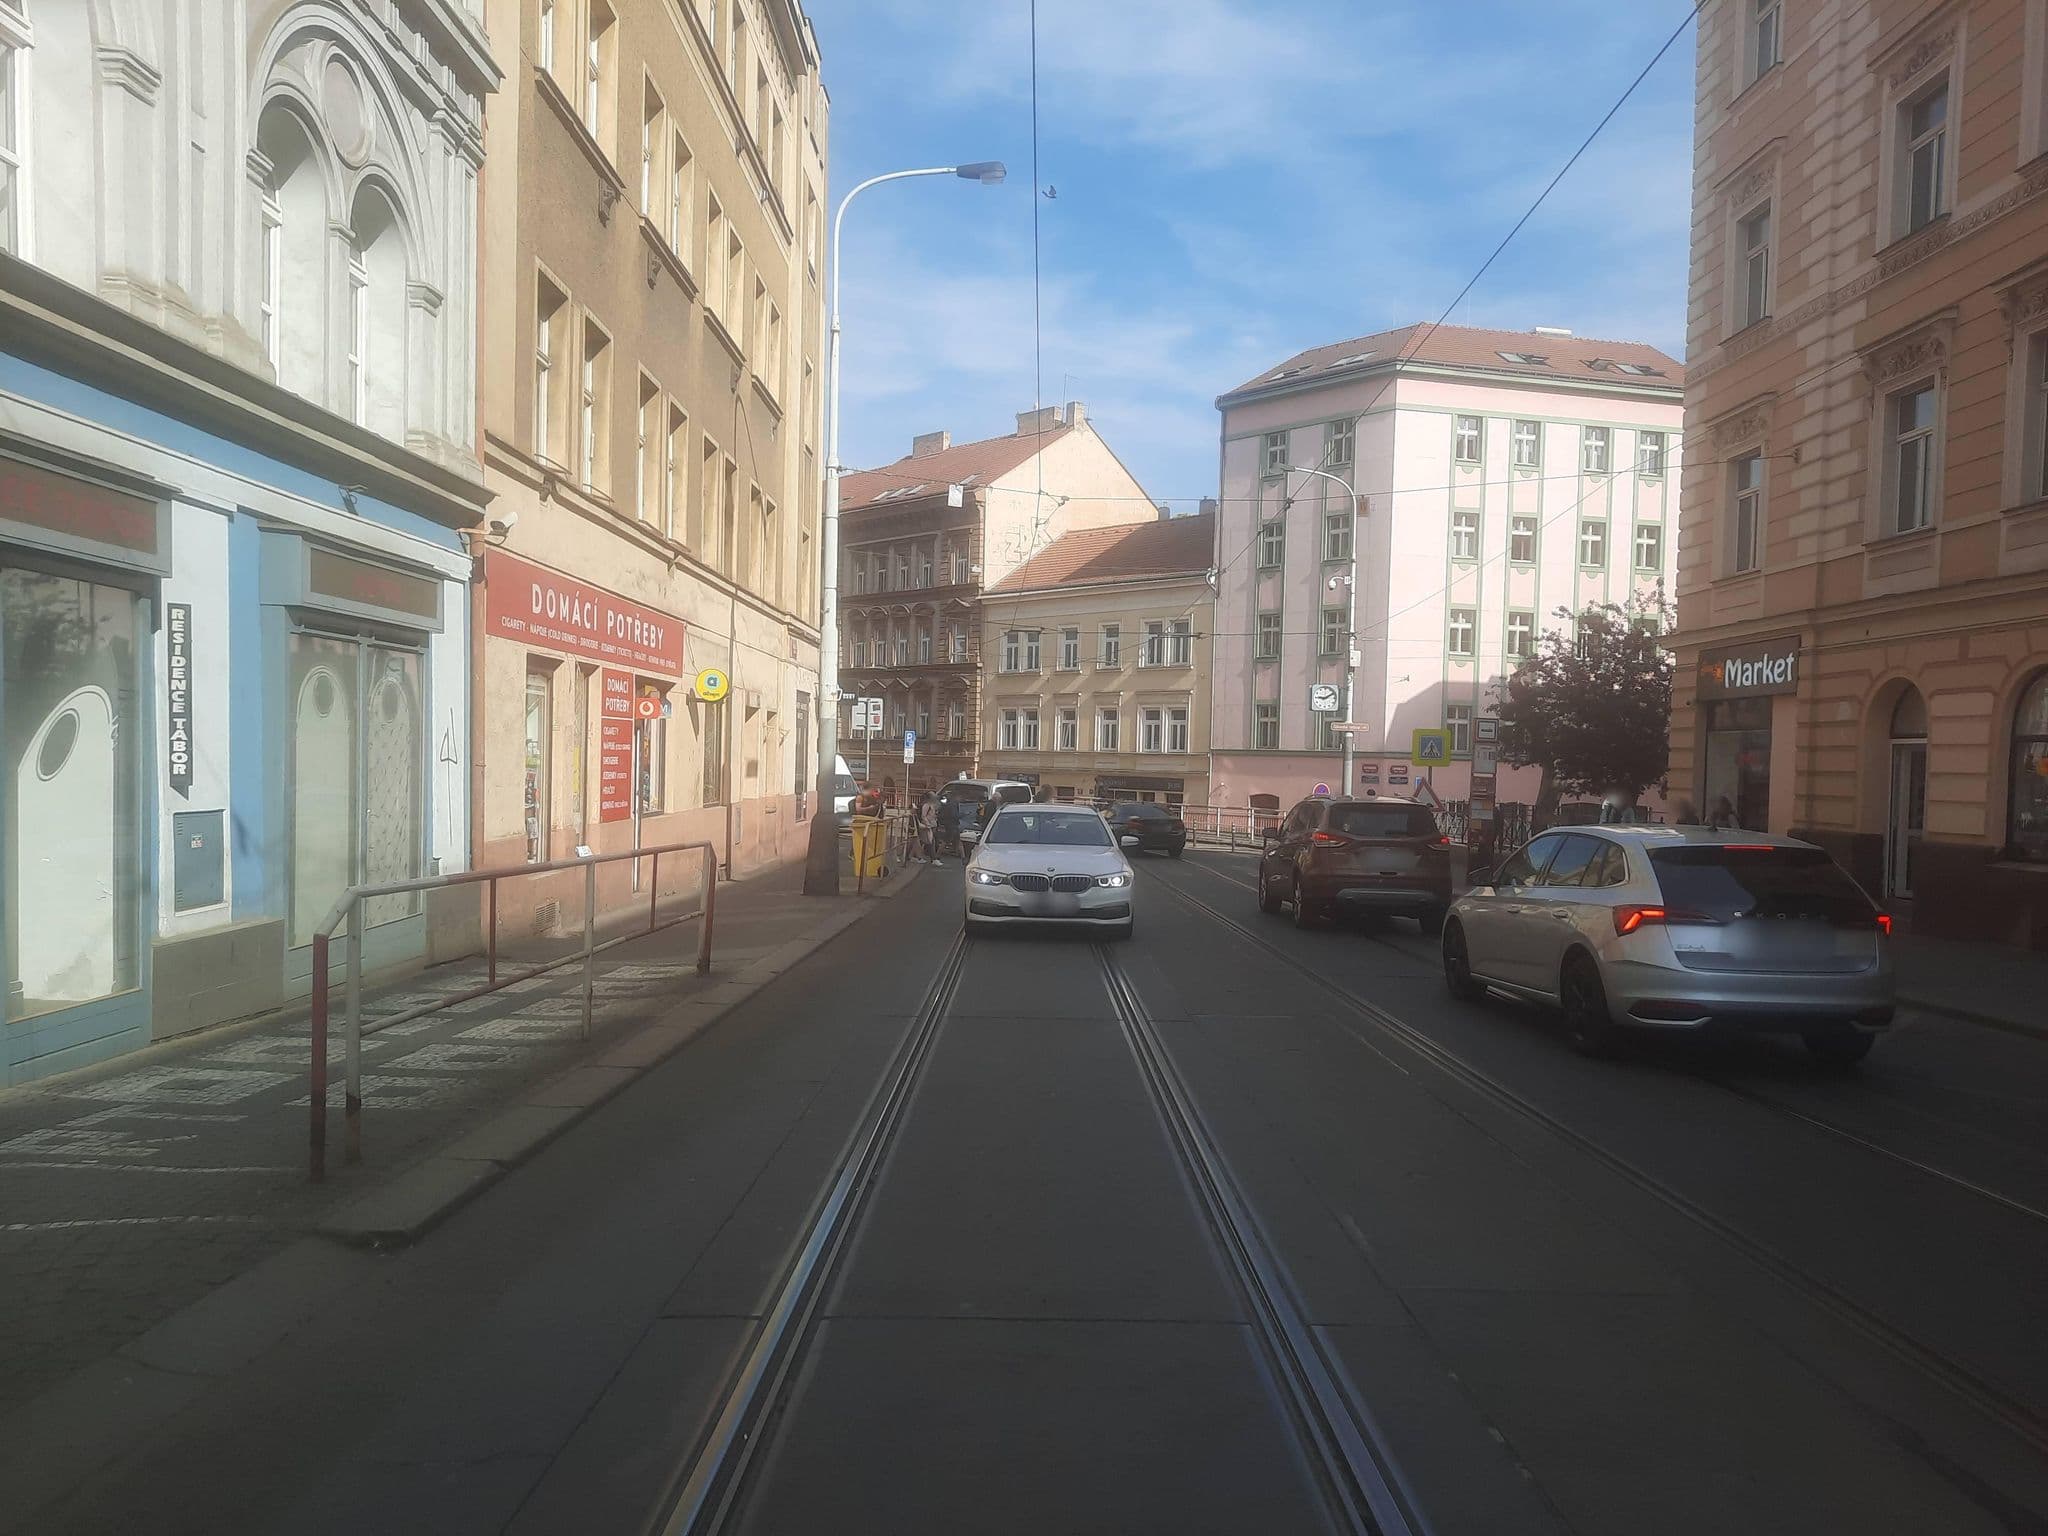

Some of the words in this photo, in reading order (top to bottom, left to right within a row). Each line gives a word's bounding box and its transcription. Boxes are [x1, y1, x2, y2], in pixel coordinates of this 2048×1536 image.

[501, 616, 526, 632] CIGARETY
[532, 583, 598, 631] DOMÁCÍ
[607, 609, 663, 650] POTŘEBY
[171, 608, 187, 713] RESIDENCE
[1725, 652, 1795, 688] Market
[607, 677, 629, 694] DOMÁCÍ
[605, 696, 630, 713] POTŘEBY
[170, 718, 189, 775] TABOR
